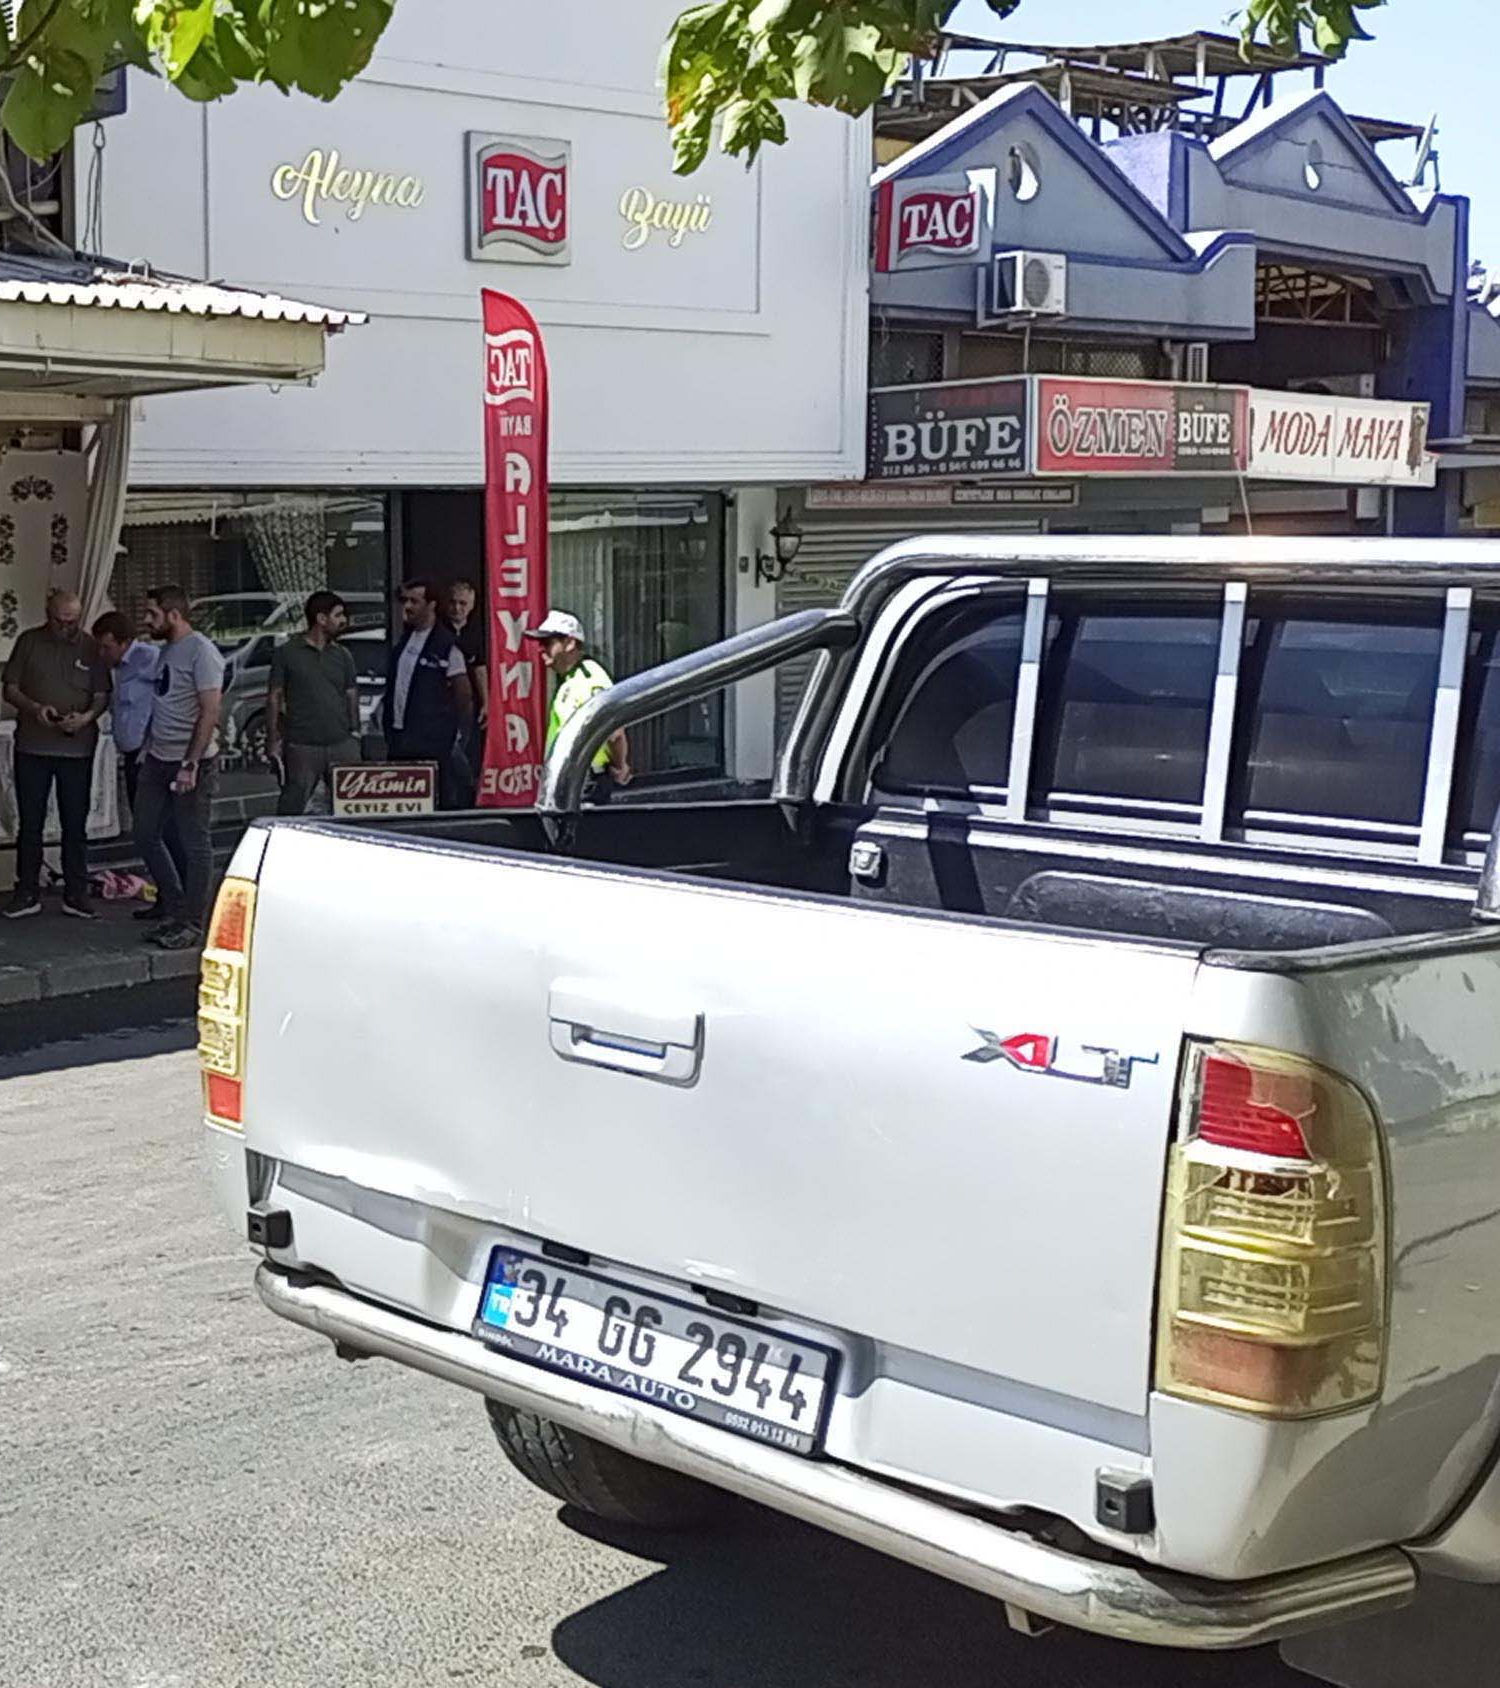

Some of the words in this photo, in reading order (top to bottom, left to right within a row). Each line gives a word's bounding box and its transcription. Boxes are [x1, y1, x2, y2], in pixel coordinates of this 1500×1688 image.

[271, 149, 424, 226] Aleyna
[486, 166, 565, 241] TAÇ
[902, 198, 972, 246] TAÇ
[883, 410, 1022, 462] BÜFE
[1048, 393, 1168, 457] ÖZMEN
[1178, 403, 1231, 443] BÜFE
[1260, 410, 1332, 457] MODA
[1337, 416, 1403, 460] MAVA
[339, 771, 427, 798] Yasmin
[514, 1268, 569, 1338] 34
[598, 1295, 663, 1367] GG
[678, 1321, 807, 1421] 2944
[535, 1343, 612, 1382] MARA
[619, 1374, 696, 1411] AUTO
